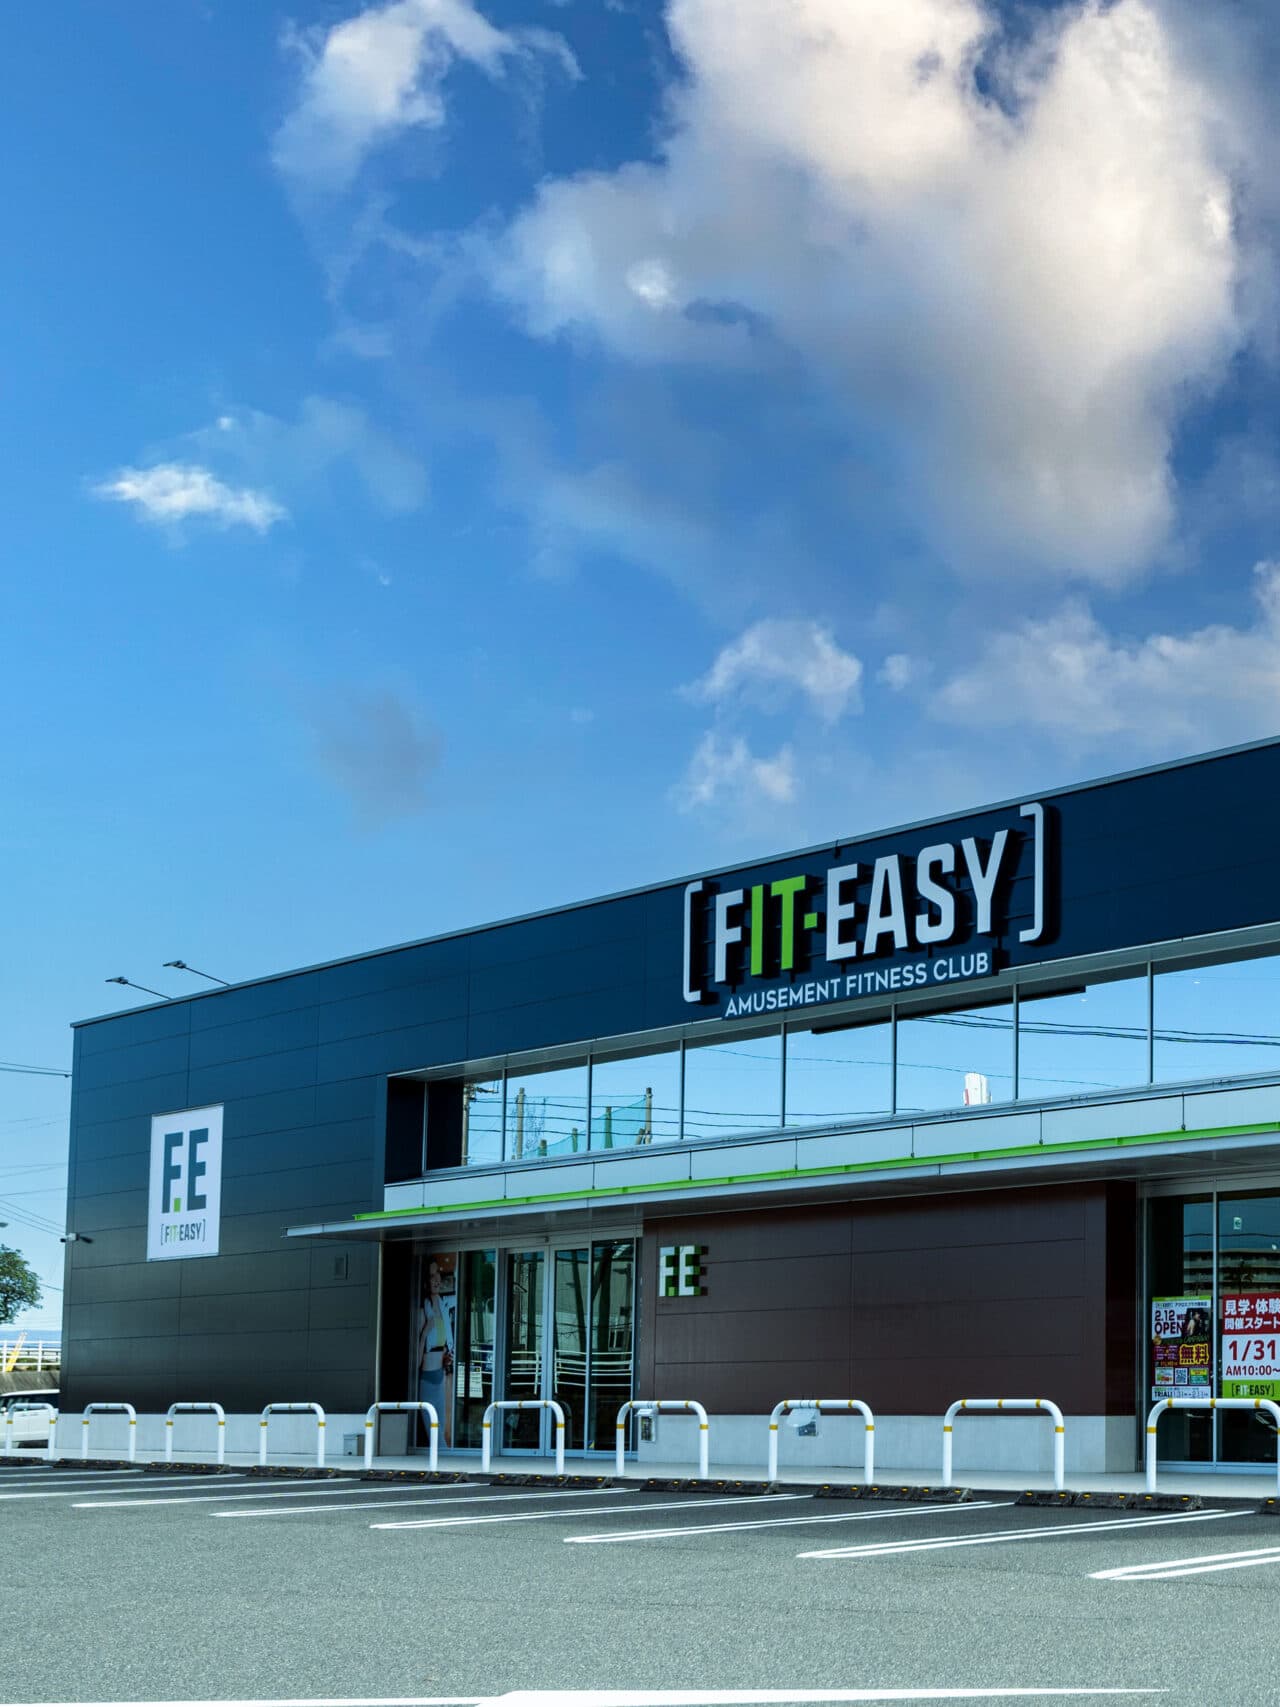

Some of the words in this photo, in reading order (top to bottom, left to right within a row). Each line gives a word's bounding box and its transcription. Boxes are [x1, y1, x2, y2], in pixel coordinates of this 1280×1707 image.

[725, 978, 840, 1017] AMUSEMENT
[846, 962, 927, 997] FITNESS
[933, 952, 989, 981] CLUB
[1155, 1309, 1175, 1321] 2.12
[1225, 1298, 1280, 1315] 見学・体験
[1154, 1321, 1185, 1335] OPEN
[1225, 1316, 1280, 1330] 開催スタート
[1179, 1344, 1209, 1365] 無料
[1229, 1339, 1276, 1361] 1/31
